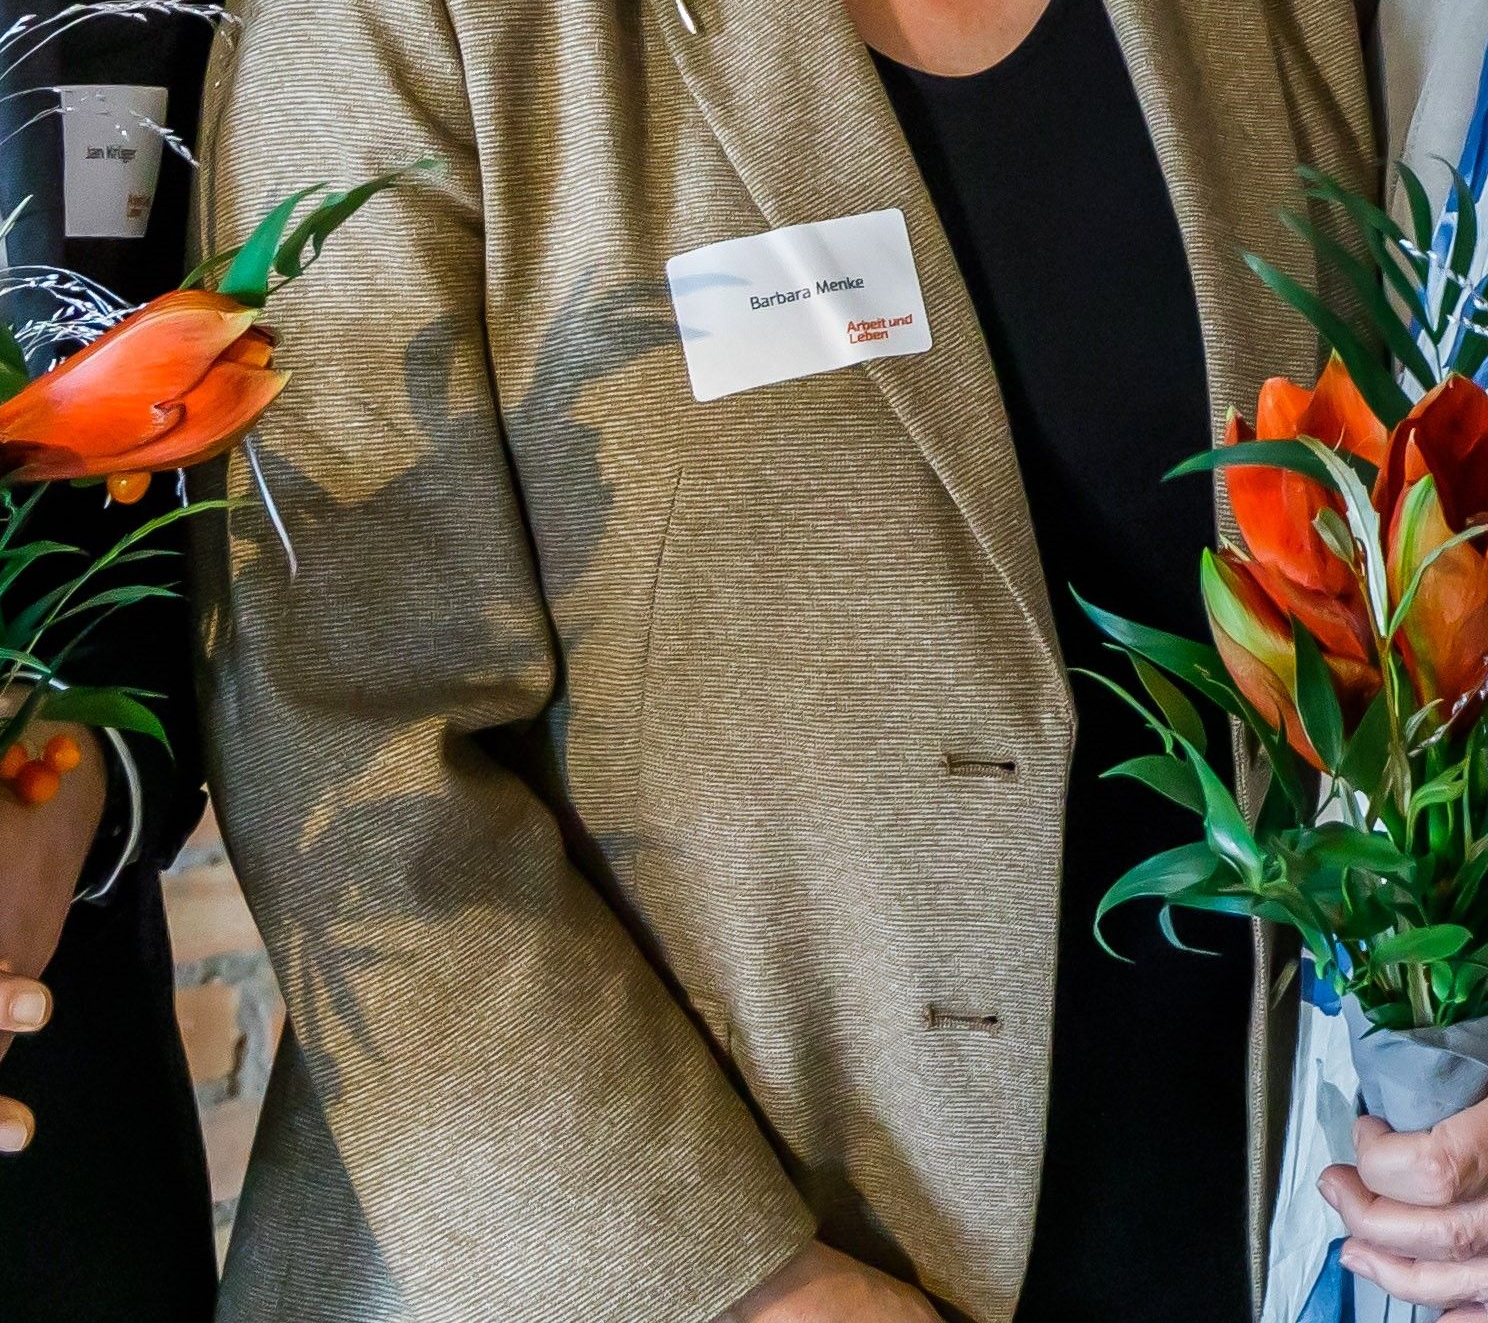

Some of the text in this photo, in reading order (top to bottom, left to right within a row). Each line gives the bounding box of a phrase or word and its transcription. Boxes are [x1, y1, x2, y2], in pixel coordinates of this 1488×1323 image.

[749, 276, 865, 311] Barbara Menke
[847, 313, 913, 334] Arbeit und
[849, 329, 889, 344] Leben
